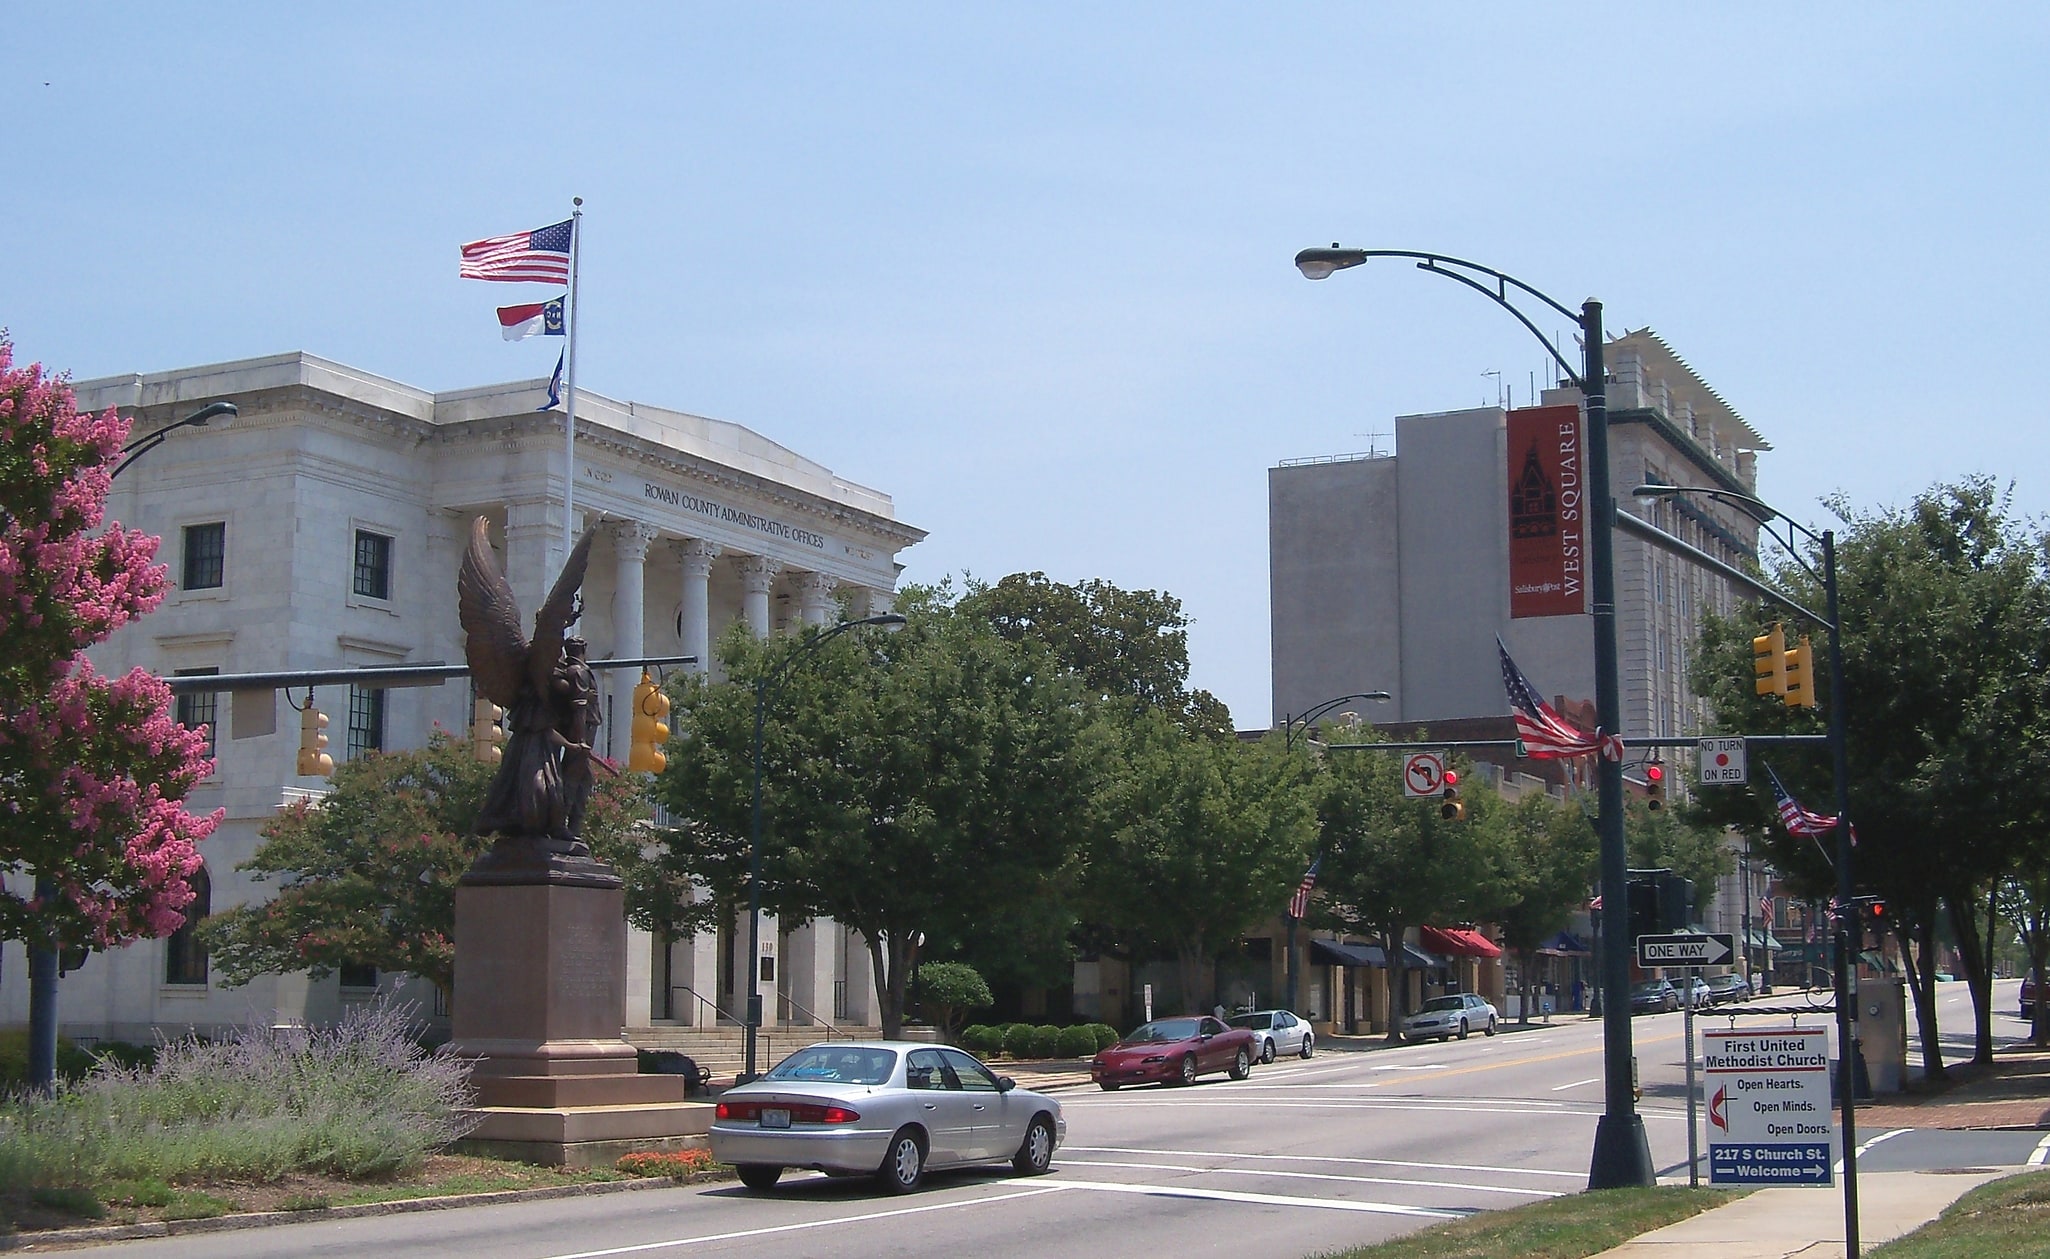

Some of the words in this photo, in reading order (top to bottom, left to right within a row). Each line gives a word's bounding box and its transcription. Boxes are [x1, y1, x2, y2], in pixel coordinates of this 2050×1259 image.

[1560, 422, 1580, 521] SQUARE
[644, 483, 679, 505] ROWAN
[682, 495, 721, 517] COUNTY
[721, 507, 790, 539] ADMINISTRATIVE
[792, 528, 824, 549] OFFICES
[1563, 530, 1580, 596] WEST
[1701, 741, 1713, 751] NO
[1718, 740, 1743, 751] TURN
[1704, 769, 1717, 780] ON
[1722, 769, 1741, 779] RED
[1649, 945, 1674, 957] ONE
[1679, 944, 1705, 956] WAY
[1725, 1041, 1756, 1053] First
[1760, 1039, 1805, 1052] United
[1706, 1055, 1773, 1067] Methodist
[1777, 1053, 1826, 1066] Church
[1737, 1079, 1763, 1092] Open
[1766, 1078, 1804, 1089] Hearts.
[1753, 1101, 1780, 1114] Open
[1782, 1100, 1816, 1112] Minds.
[1767, 1124, 1794, 1137] Open
[1796, 1124, 1830, 1134] Doors.
[1715, 1149, 1739, 1160] 217
[1742, 1149, 1751, 1160] S
[1755, 1148, 1803, 1160] Church
[1806, 1148, 1826, 1160] St.
[1736, 1165, 1801, 1177] Welcome
